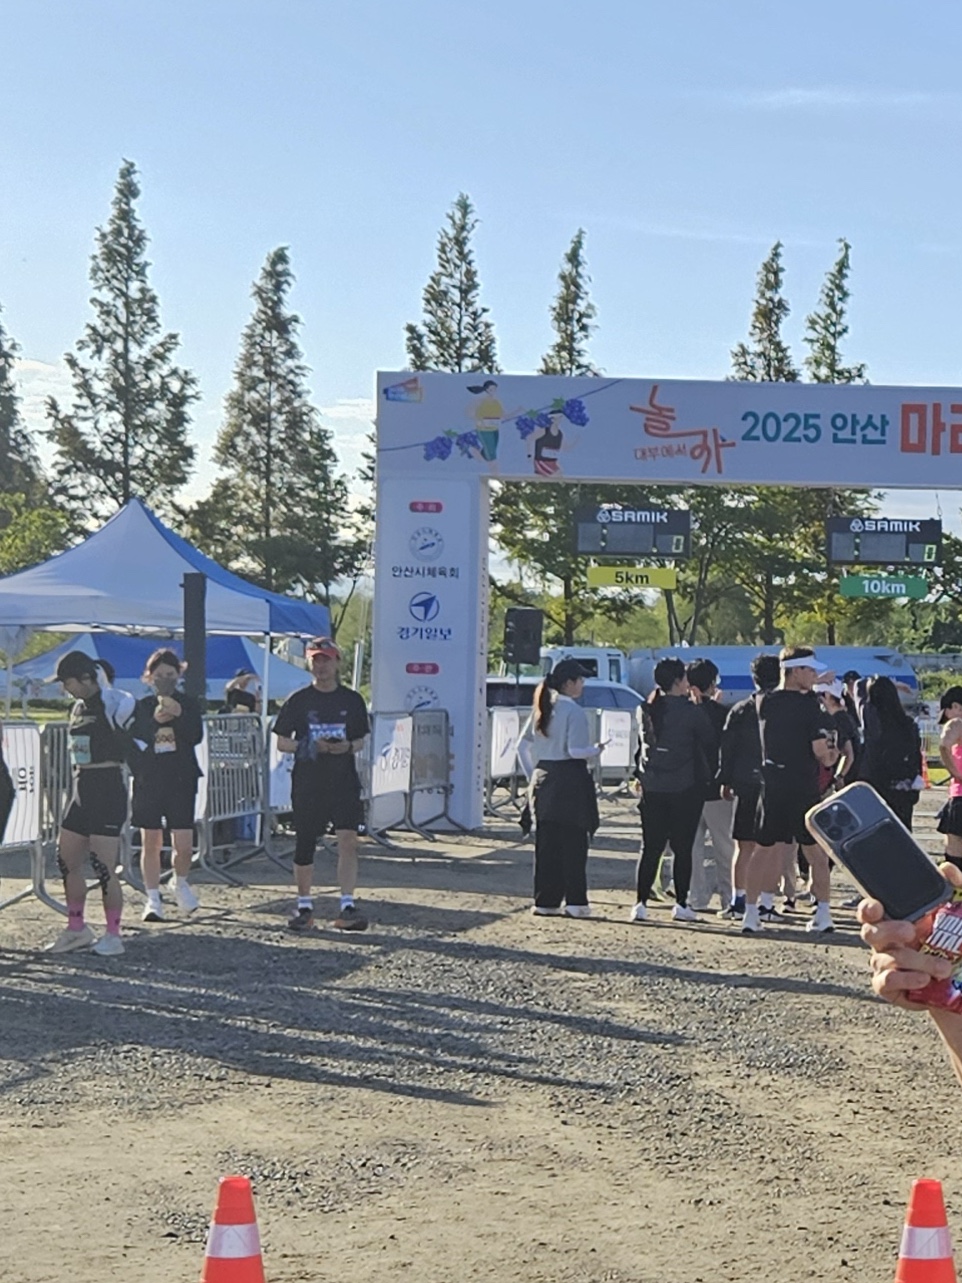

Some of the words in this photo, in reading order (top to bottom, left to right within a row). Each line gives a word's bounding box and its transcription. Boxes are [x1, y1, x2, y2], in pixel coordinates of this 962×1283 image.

[741, 411, 822, 443] 2025
[831, 412, 889, 445] 안산
[611, 510, 668, 523] SAMIK
[864, 520, 921, 532] SAMIK
[924, 544, 937, 562] 0
[392, 566, 460, 579] 안산시체육회
[614, 571, 650, 585] 5km
[862, 580, 906, 594] 10km
[397, 626, 453, 641] 경기일보
